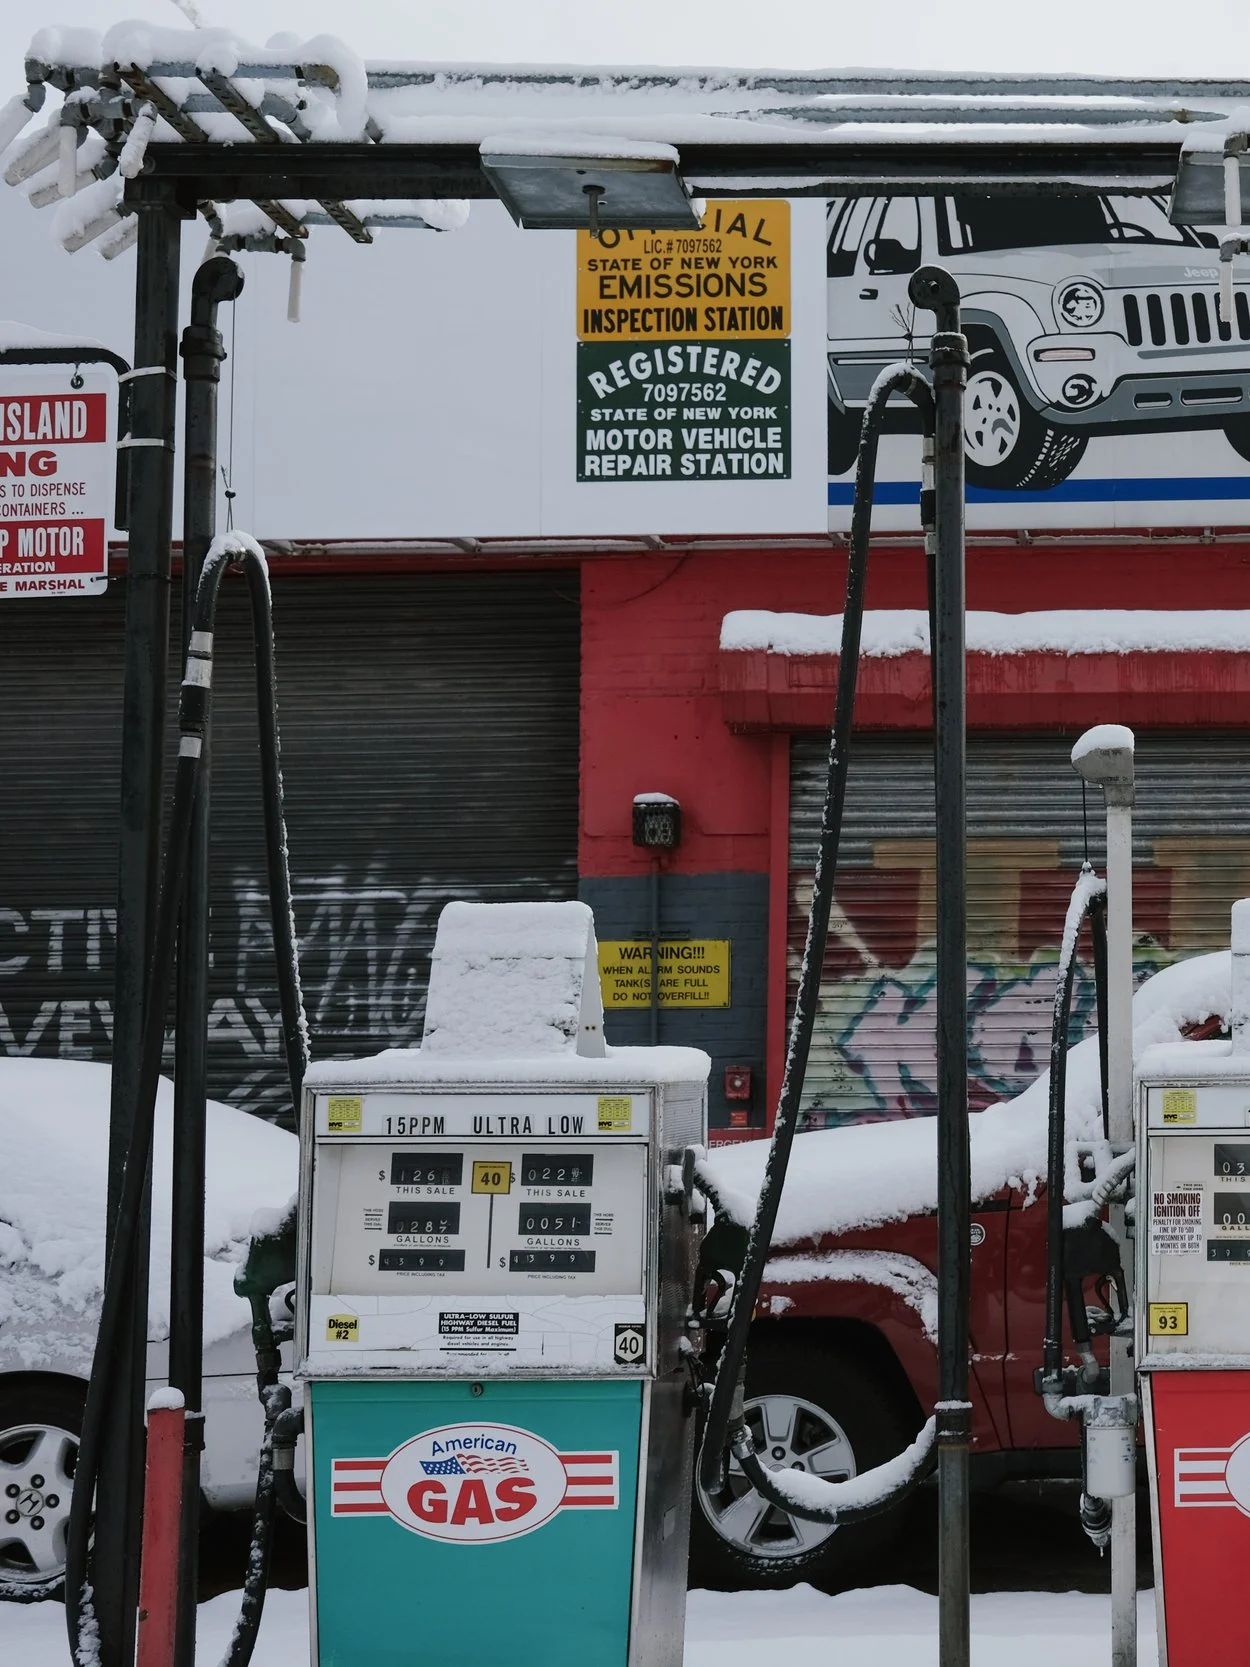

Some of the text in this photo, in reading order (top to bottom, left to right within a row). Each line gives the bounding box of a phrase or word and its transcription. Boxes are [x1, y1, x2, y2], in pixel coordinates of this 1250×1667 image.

[676, 238, 722, 254] 7097562
[588, 256, 777, 271] STATE OF NEW YORK
[1184, 266, 1218, 278] Jeep
[599, 272, 768, 299] EMISSIONS
[584, 306, 783, 333] INSPECTION STATION
[588, 345, 782, 399] REGISTERED
[642, 383, 727, 402] 7097562
[0, 401, 87, 441] ISLAND
[590, 406, 777, 421] STATE OF NEW YORK
[586, 427, 782, 450] MOTOR VEHICLE
[585, 453, 784, 476] REPAIR STATION
[12, 484, 25, 497] TO
[30, 482, 86, 496] DISPENSE
[0, 502, 66, 517] ONTAINERS
[18, 526, 84, 557] MOTOR
[15, 579, 85, 591] MARSHAL
[619, 947, 705, 960] WARNING!!!
[603, 965, 720, 975] WHEN ALRM SOUNDS
[659, 979, 679, 988] ARE
[684, 979, 708, 987] FULL
[613, 991, 710, 1001] DO NOT OVERFILL!!
[386, 1116, 584, 1134] 15PPM ULTRA LOW
[481, 1172, 501, 1186] 40
[1154, 1193, 1201, 1204] NO SMOKING
[1154, 1206, 1200, 1217] IGNITION OFF
[396, 1235, 449, 1243] GALLONS
[527, 1238, 580, 1246] GALLONS
[328, 1319, 357, 1330] Diesel
[1159, 1316, 1178, 1329] 93
[336, 1330, 349, 1340] #2
[619, 1337, 639, 1353] 40
[431, 1434, 517, 1456] American
[407, 1477, 537, 1525] GAS
